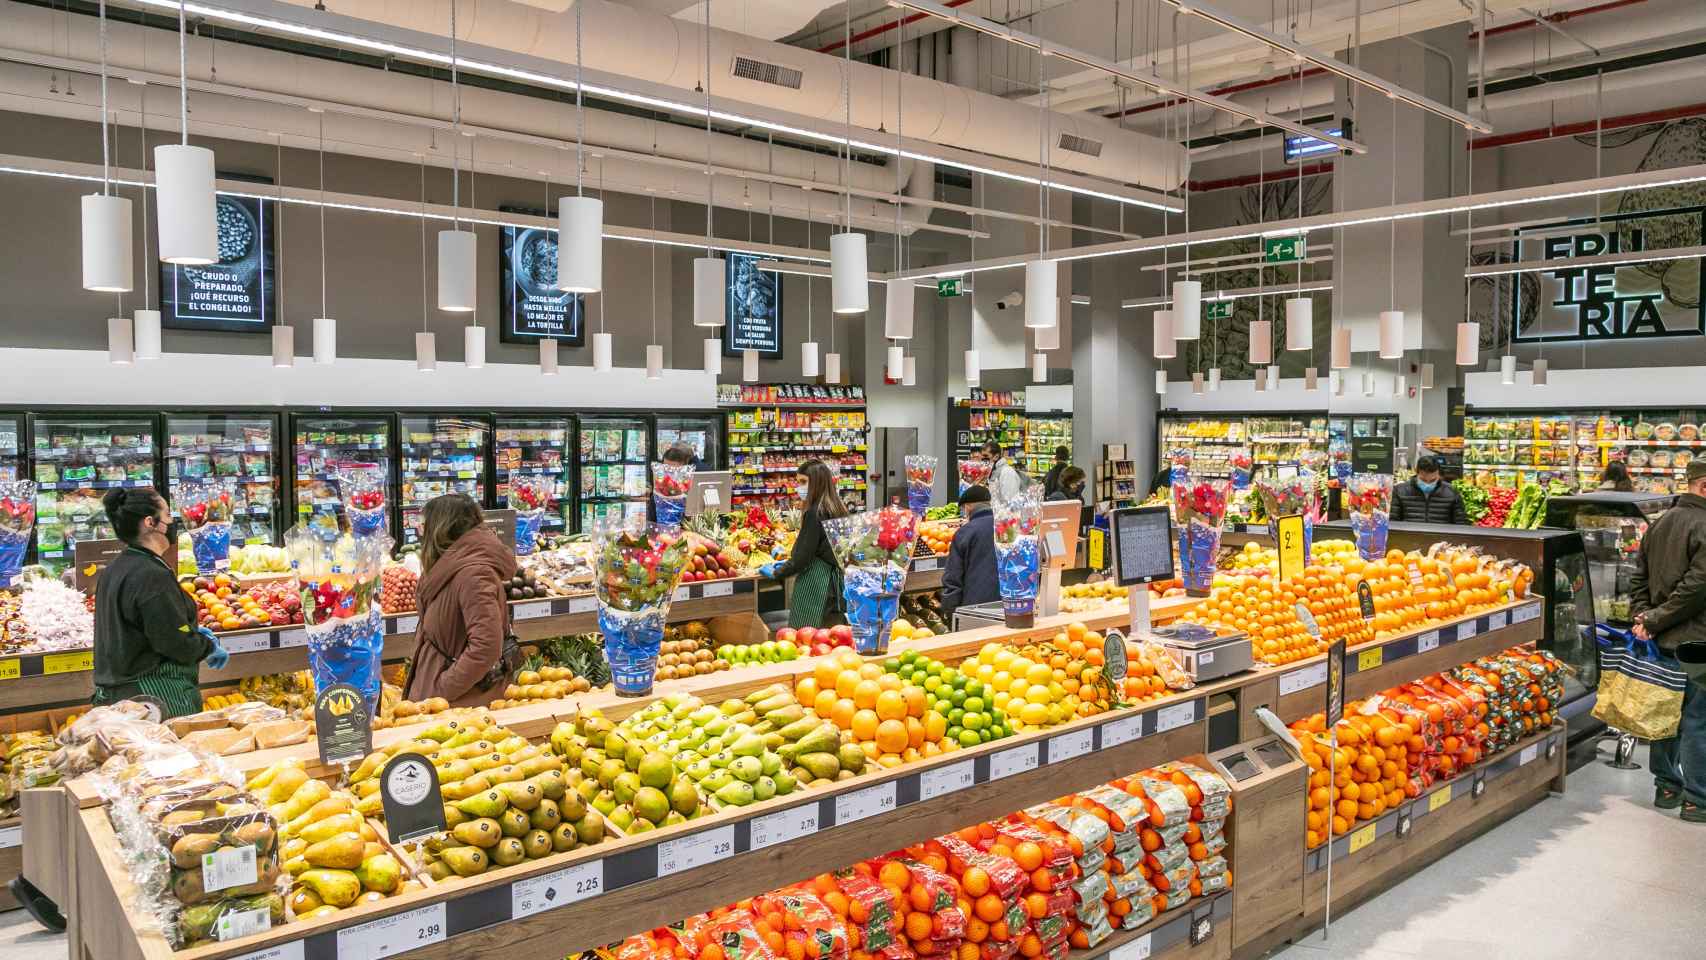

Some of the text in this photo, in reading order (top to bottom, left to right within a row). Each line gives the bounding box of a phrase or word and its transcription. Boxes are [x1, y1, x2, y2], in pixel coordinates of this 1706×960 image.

[202, 272, 230, 280] CRUDO
[1553, 262, 1662, 304] TE
[191, 292, 250, 302] ¡QUÉ RECURSO
[200, 303, 251, 312] CONGELADO!
[1580, 300, 1666, 335] RIA
[714, 841, 730, 854] 2,29
[576, 877, 598, 894] 2,25
[418, 924, 440, 939] 2,99
